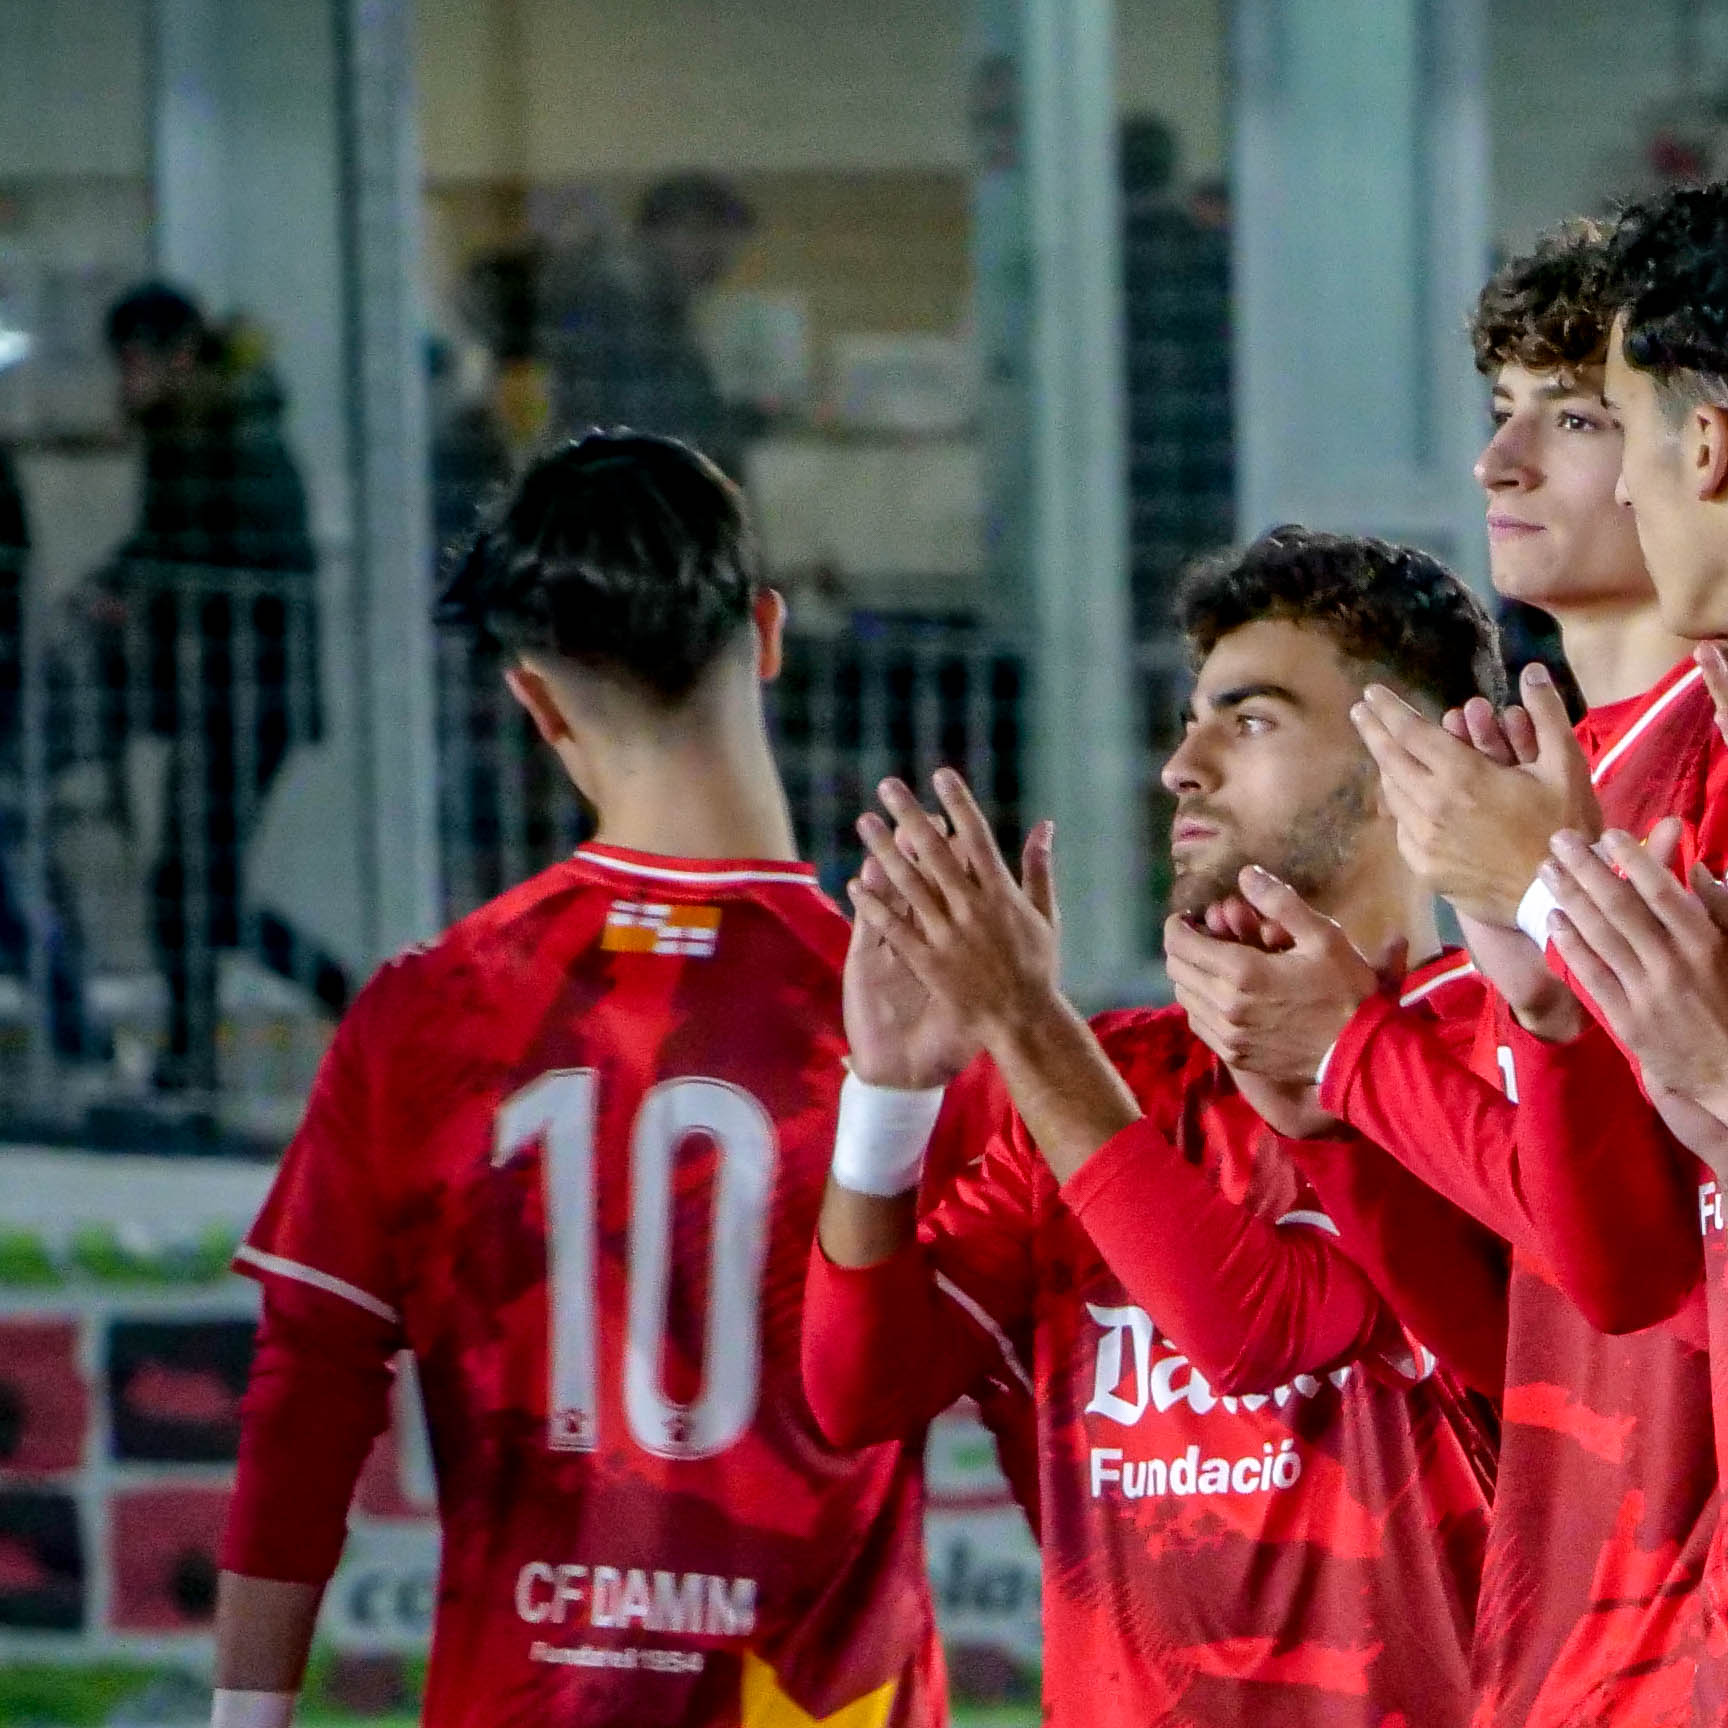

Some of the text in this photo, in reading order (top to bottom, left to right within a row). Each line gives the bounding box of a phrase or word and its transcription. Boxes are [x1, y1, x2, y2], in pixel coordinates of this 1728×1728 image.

[490, 1066, 782, 1462] 10
[1089, 1436, 1303, 1500] Fundació
[514, 1560, 590, 1625] CF
[590, 1564, 759, 1637] DAMM
